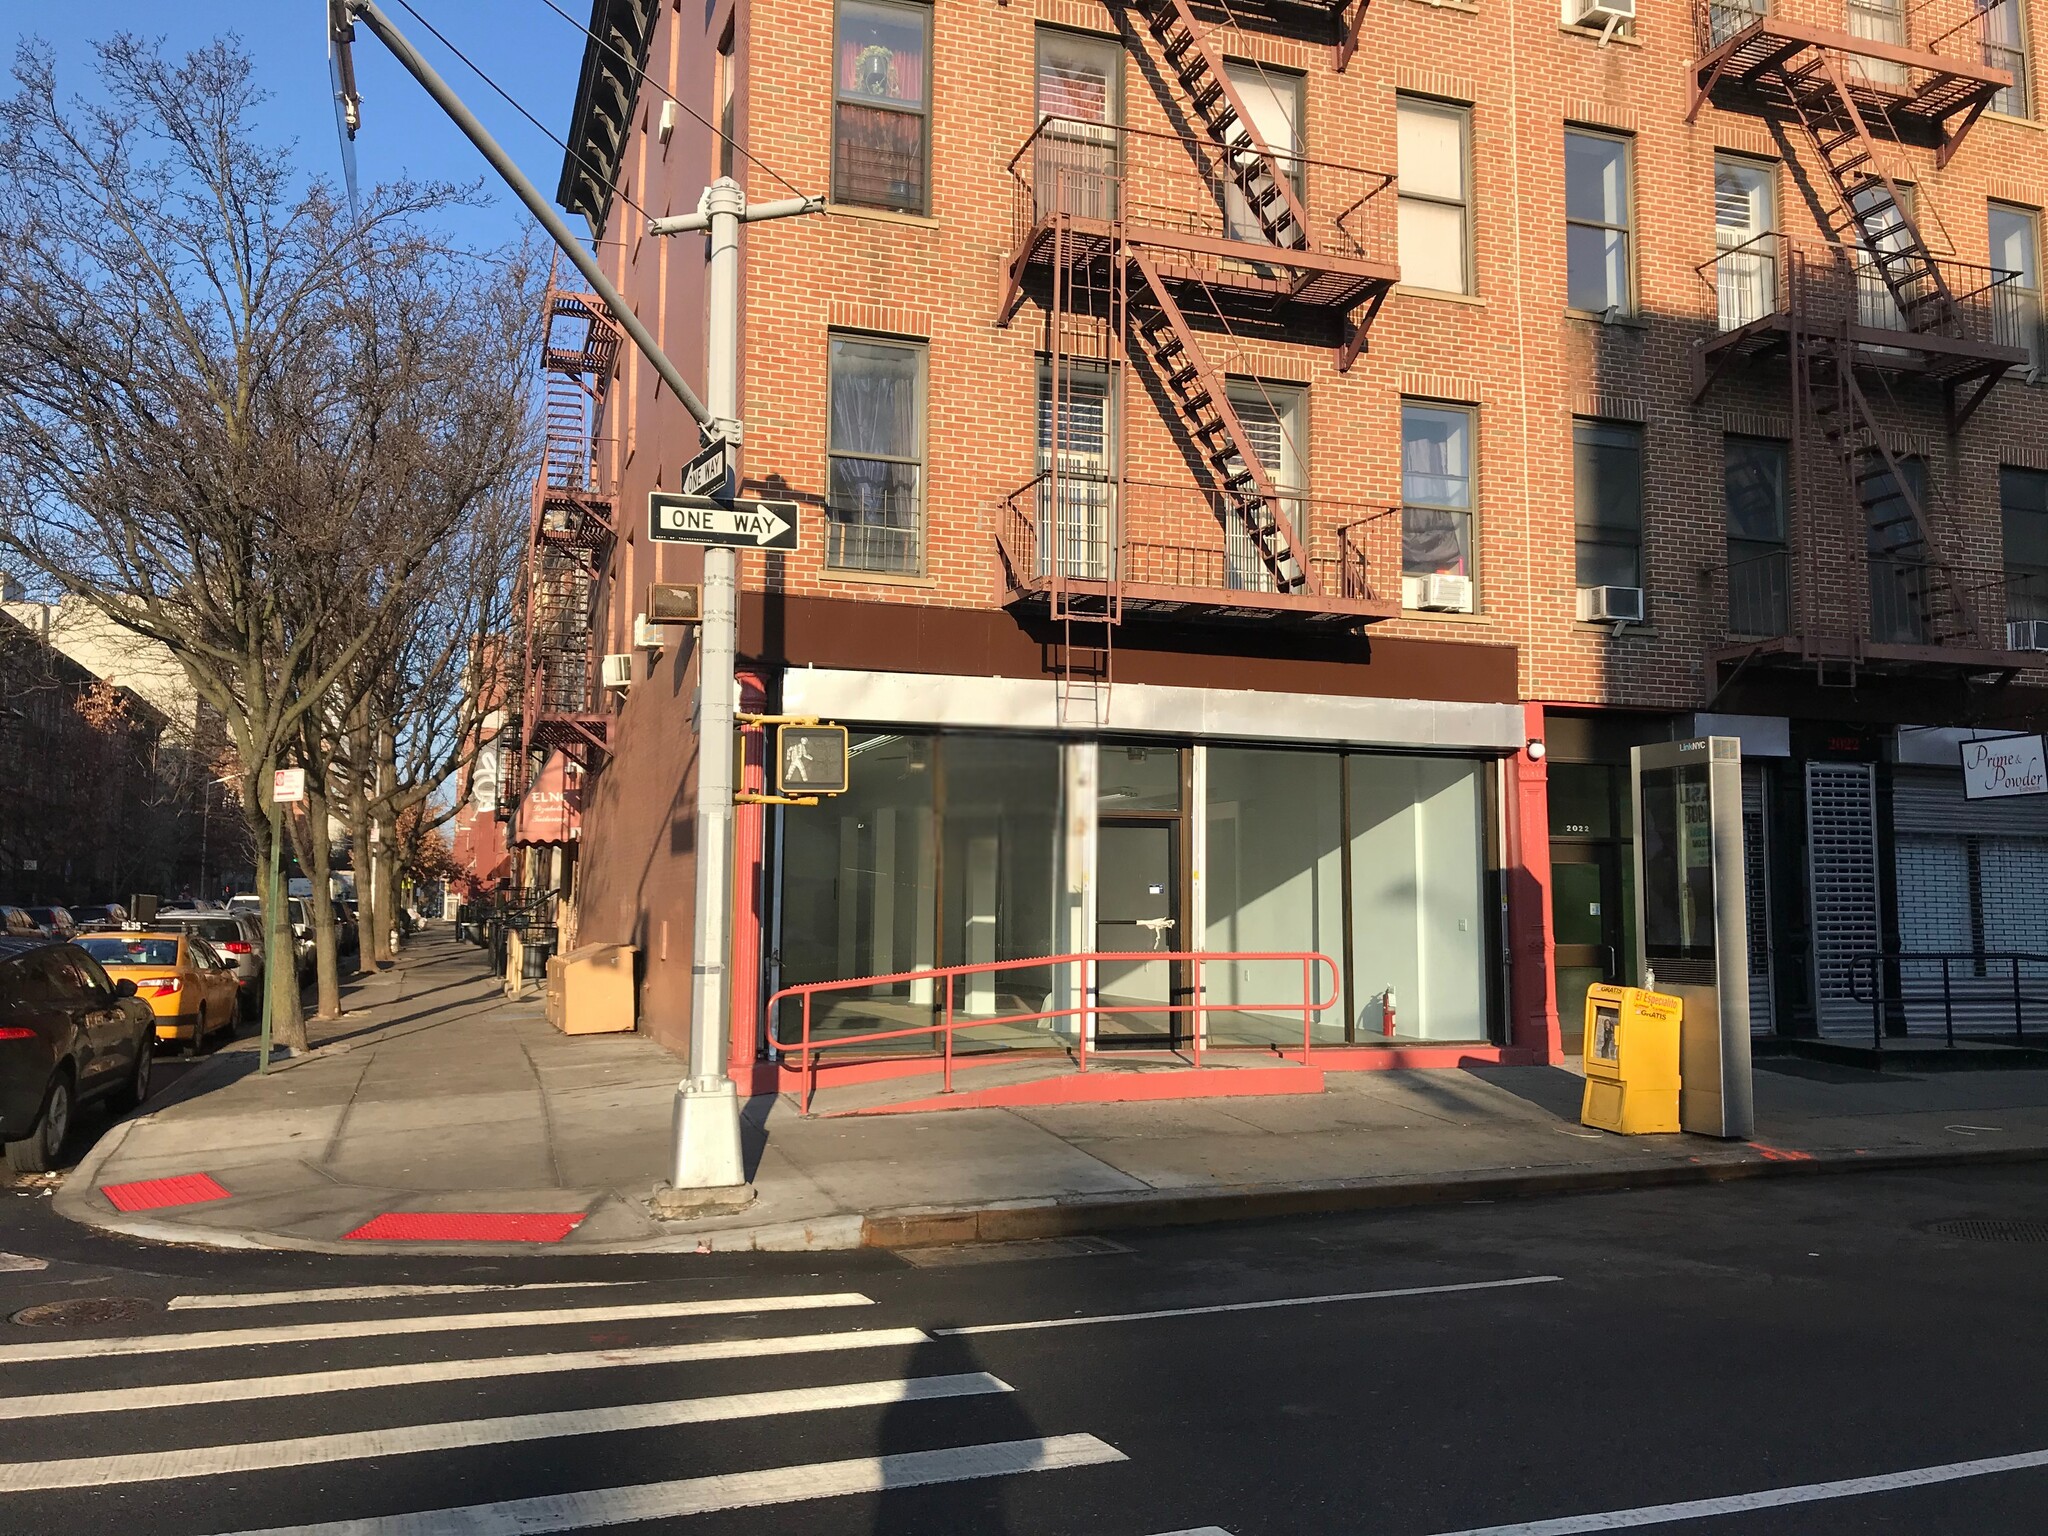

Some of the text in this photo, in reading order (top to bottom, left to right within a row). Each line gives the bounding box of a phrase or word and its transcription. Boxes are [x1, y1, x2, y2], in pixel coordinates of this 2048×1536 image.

[688, 469, 701, 492] ONE
[704, 455, 720, 481] WAY
[672, 510, 776, 534] ONE WAY
[1679, 741, 1706, 752] LinkNYC
[1967, 744, 2022, 770] Prime &
[1985, 756, 2043, 791] Powder
[1566, 824, 1590, 832] 2022
[1601, 986, 1622, 994] GRATIS
[1635, 991, 1642, 1001] El
[1644, 993, 1678, 1009] Especialito
[1641, 1010, 1666, 1020] GRATIS
